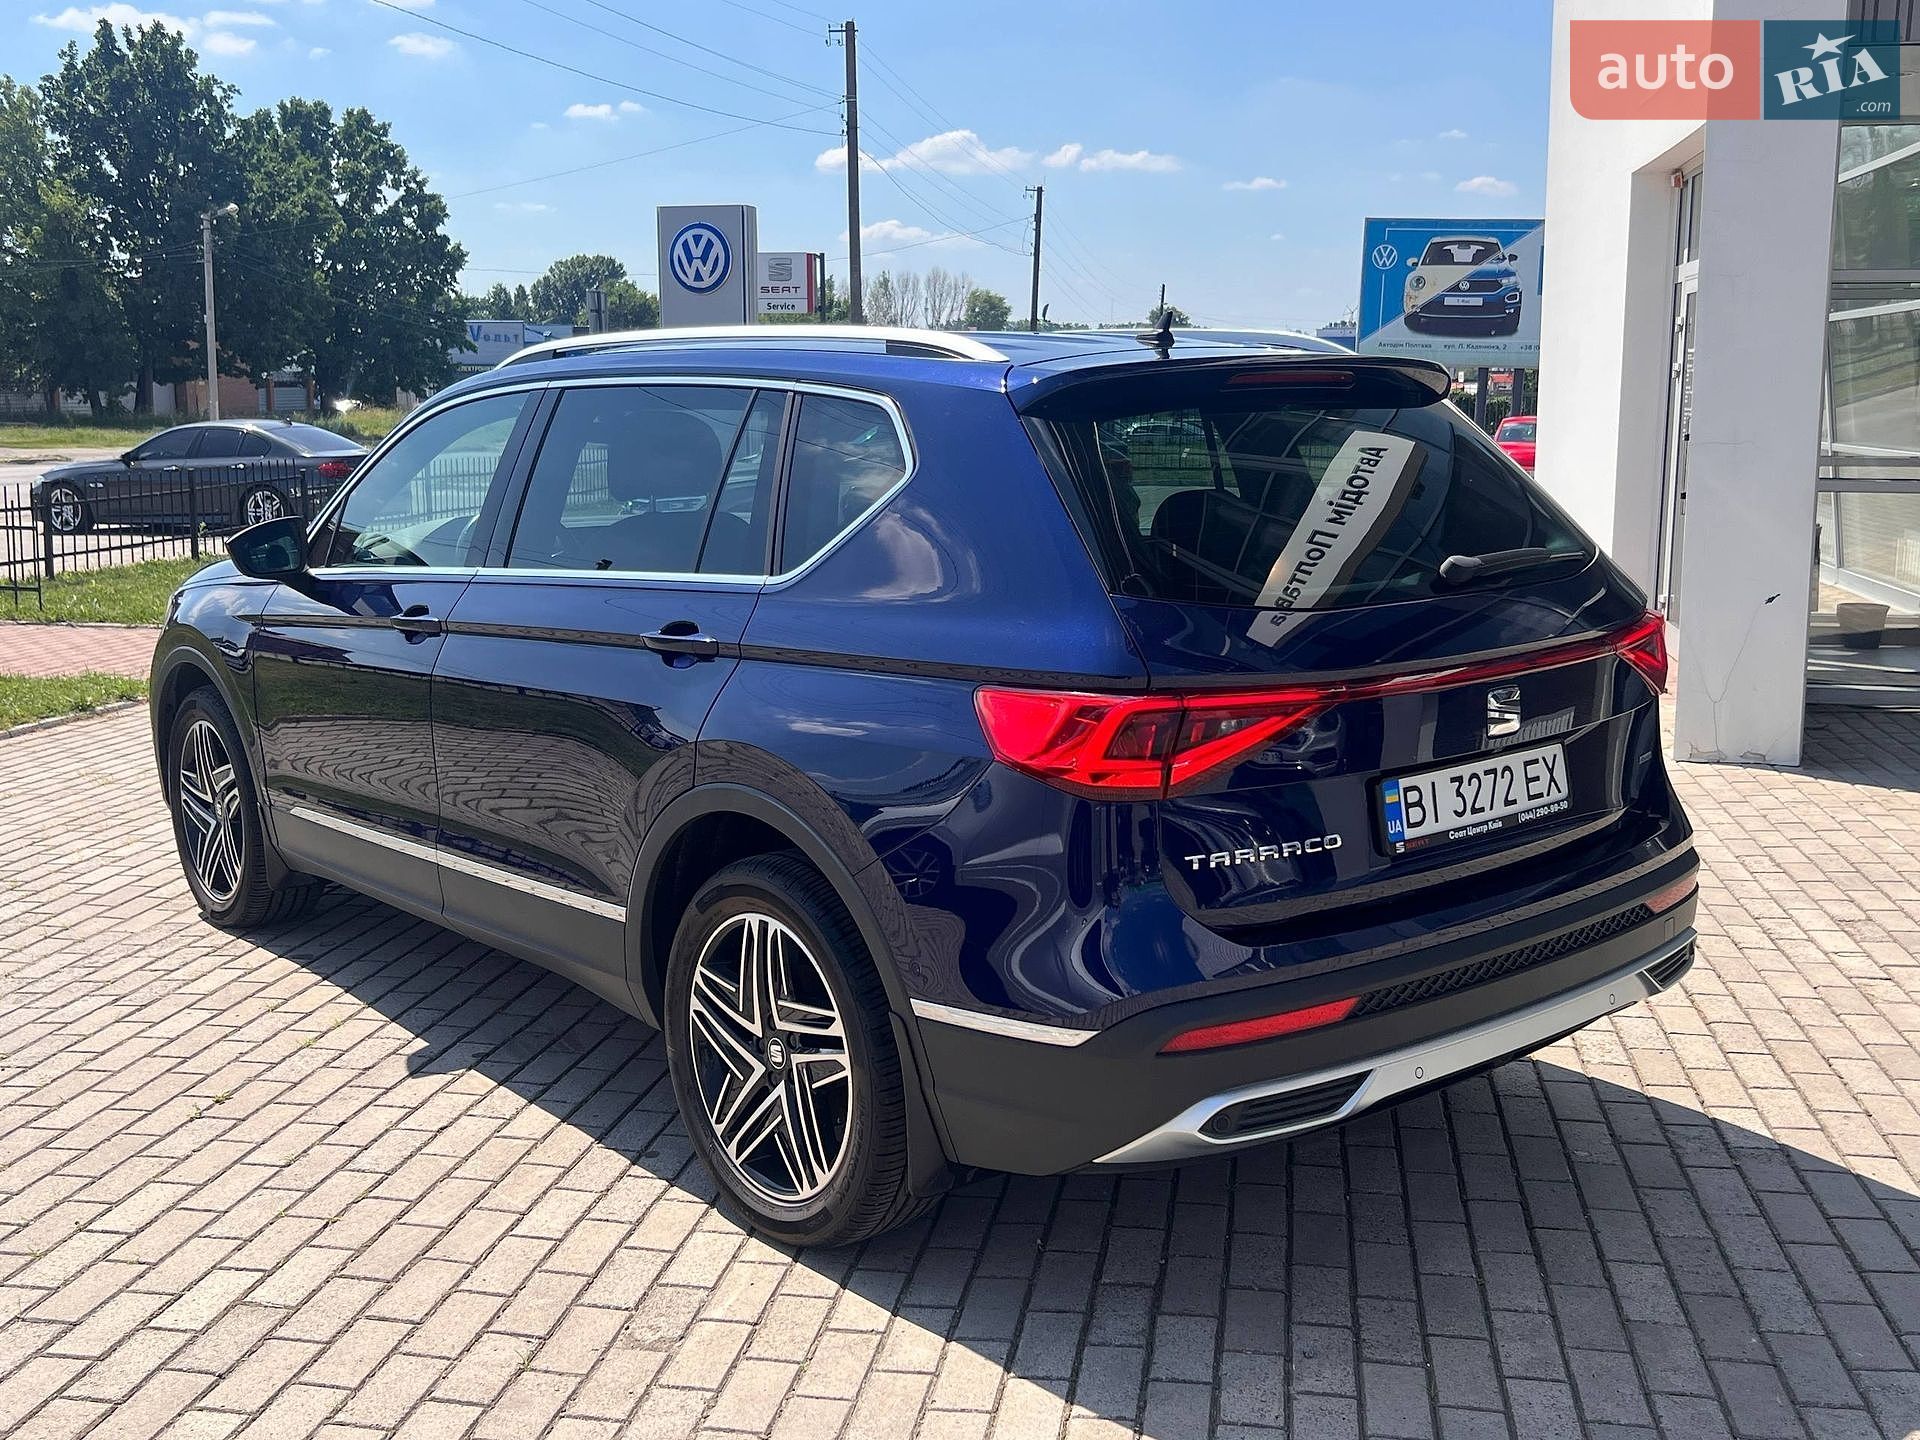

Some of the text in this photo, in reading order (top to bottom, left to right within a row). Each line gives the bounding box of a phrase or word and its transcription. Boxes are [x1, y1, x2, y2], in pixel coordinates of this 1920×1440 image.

[760, 286, 801, 294] SEAT
[766, 302, 796, 311] Service
[1402, 753, 1562, 829] BI 3272 EX
[1387, 819, 1402, 834] UA
[1184, 833, 1343, 871] TARRACO
